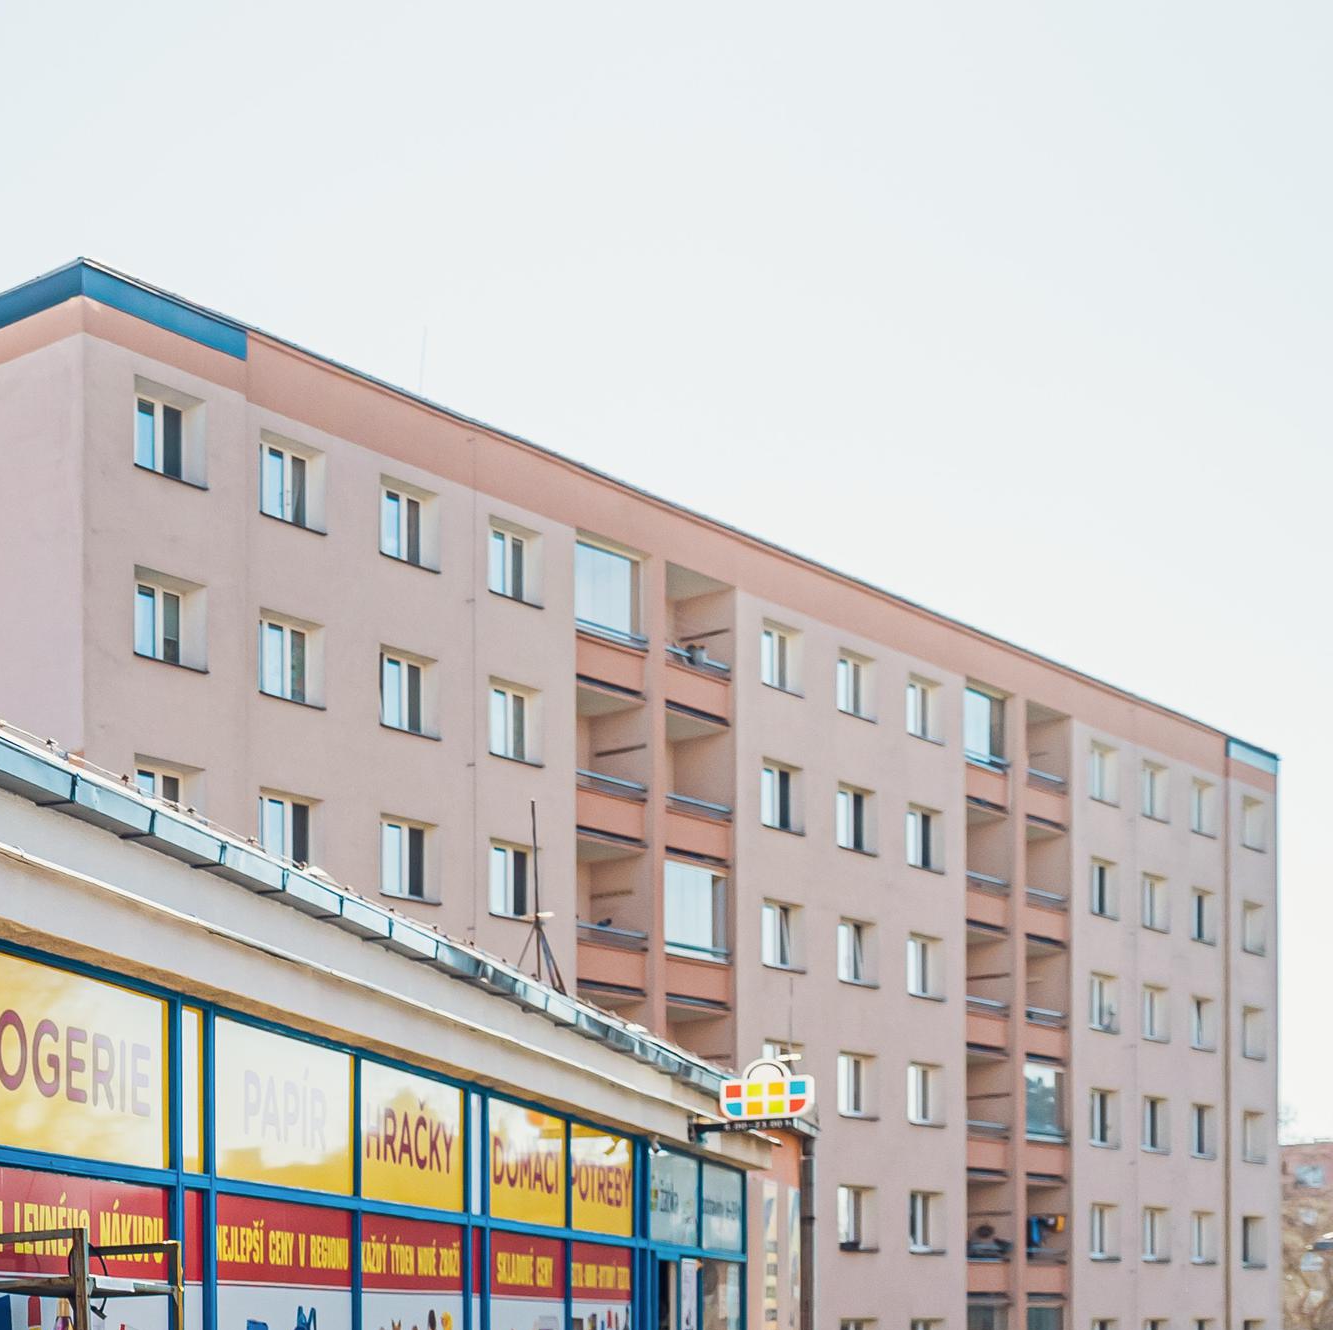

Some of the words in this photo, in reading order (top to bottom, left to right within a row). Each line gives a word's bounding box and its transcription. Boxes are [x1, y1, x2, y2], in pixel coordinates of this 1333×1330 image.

[244, 1067, 326, 1151] PAPÍR
[366, 1098, 454, 1174] HRAČKY
[99, 1199, 164, 1264] NÁKUPU
[216, 1218, 264, 1264] NEJLEPŠÍ
[268, 1230, 294, 1267] CENY
[298, 1233, 306, 1268] V
[310, 1234, 349, 1271] REGIONU
[361, 1234, 387, 1275] KAŽDÝ
[390, 1235, 415, 1276] TÝDEN
[417, 1238, 437, 1277] NOVÉ
[439, 1240, 460, 1278] ZBOŽÍ
